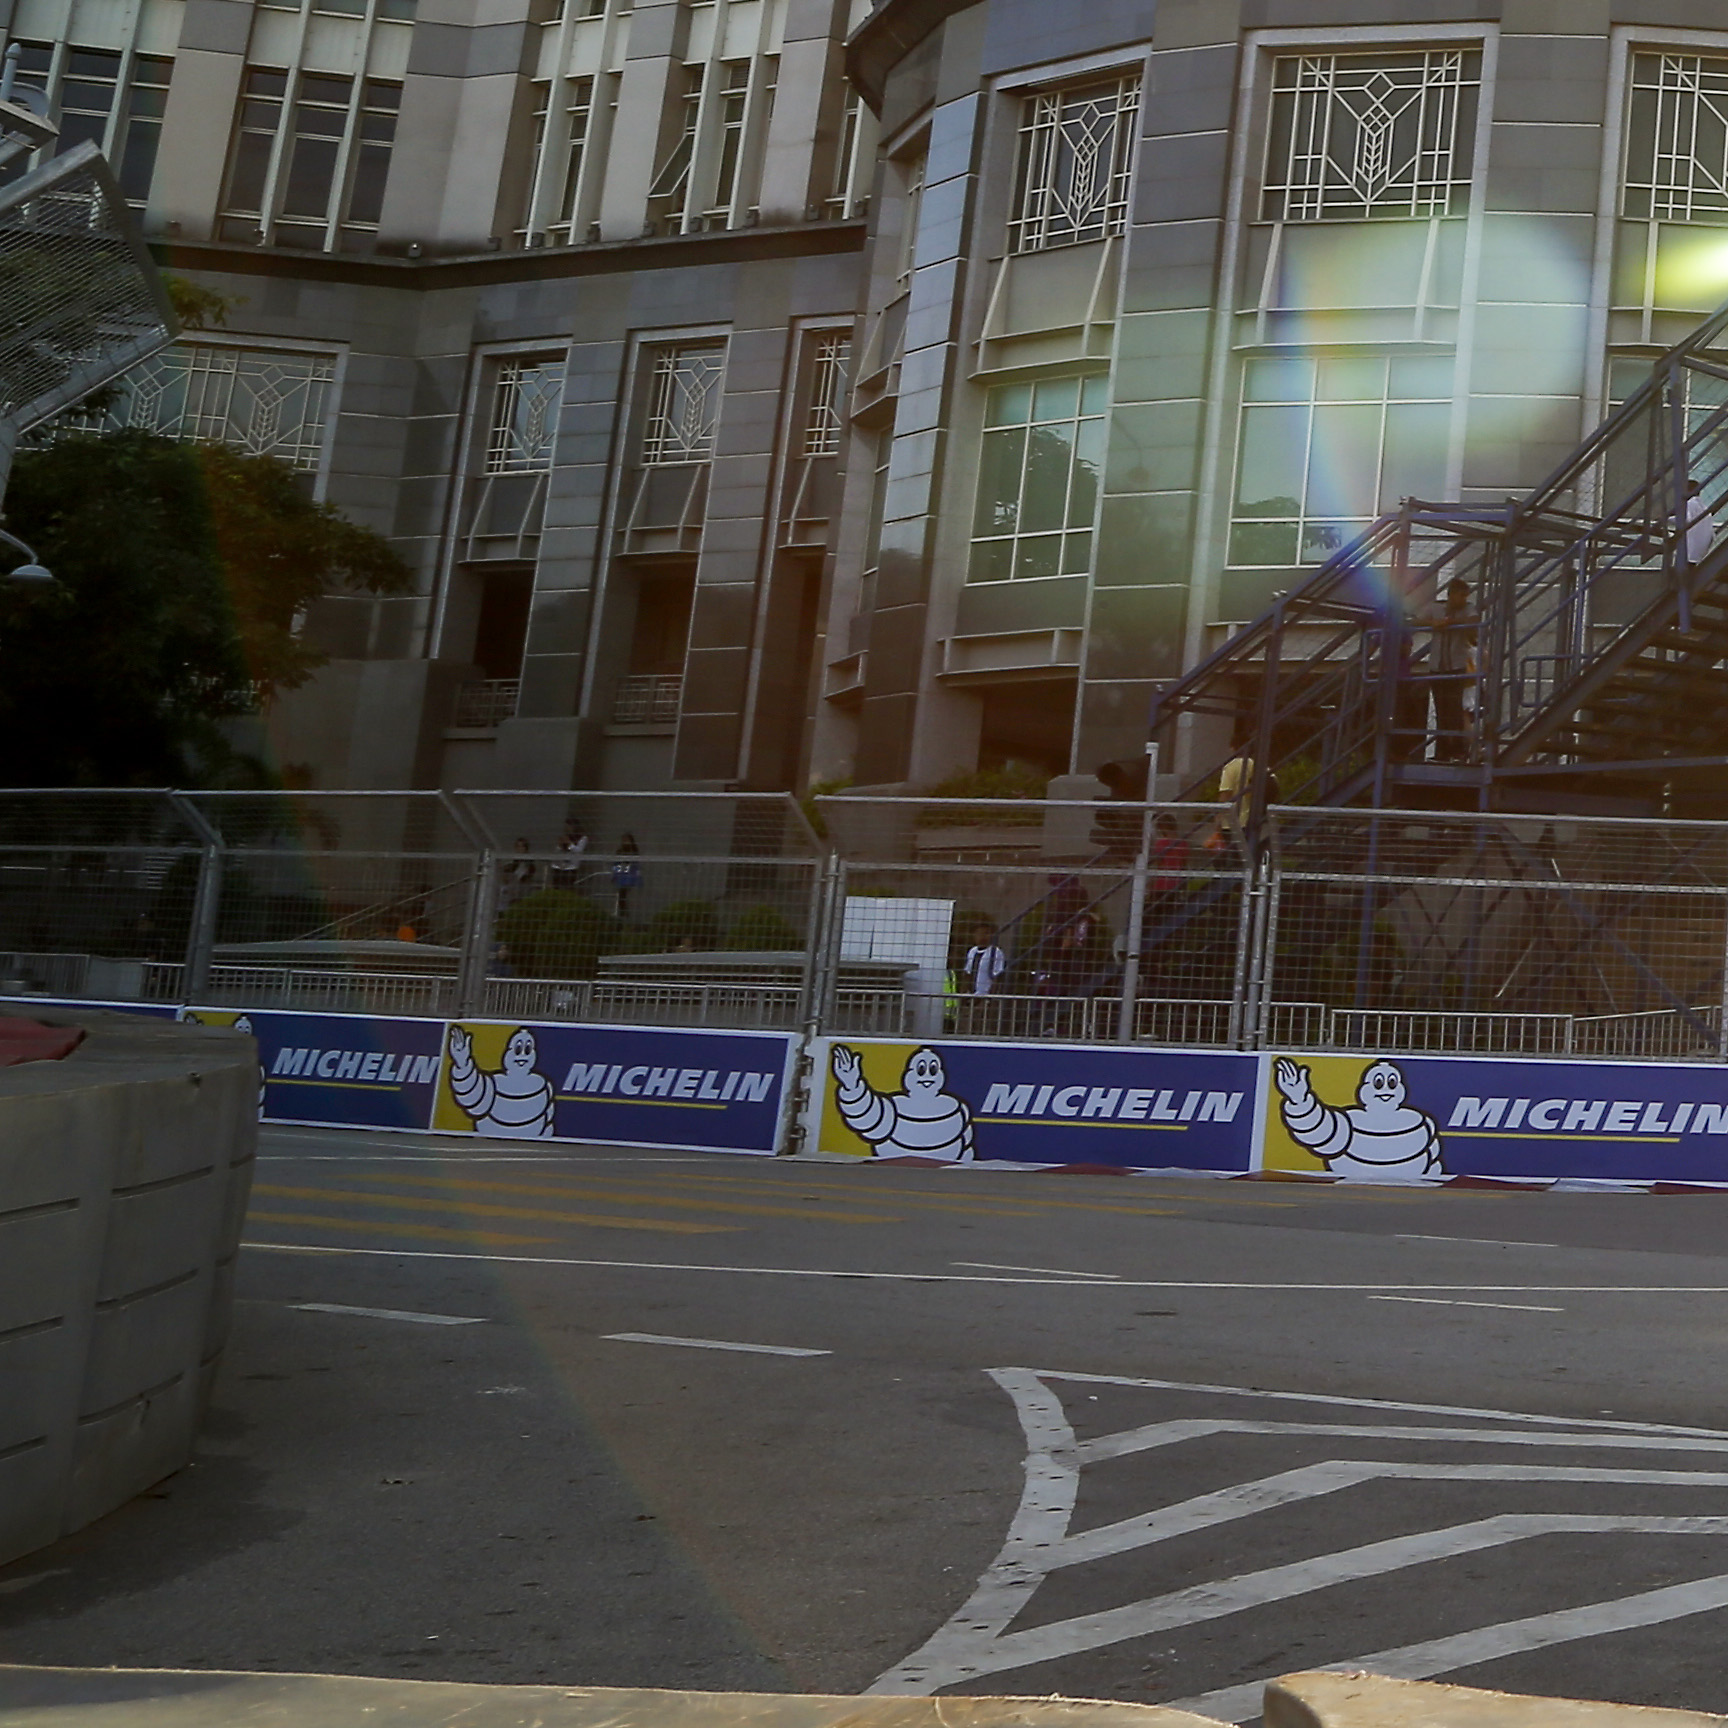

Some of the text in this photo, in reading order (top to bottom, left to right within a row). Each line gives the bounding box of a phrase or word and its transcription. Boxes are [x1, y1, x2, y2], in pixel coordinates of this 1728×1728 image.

[271, 1046, 441, 1084] MICHELIN
[561, 1062, 775, 1102] MICHELIN
[980, 1083, 1245, 1123] MICHELIN
